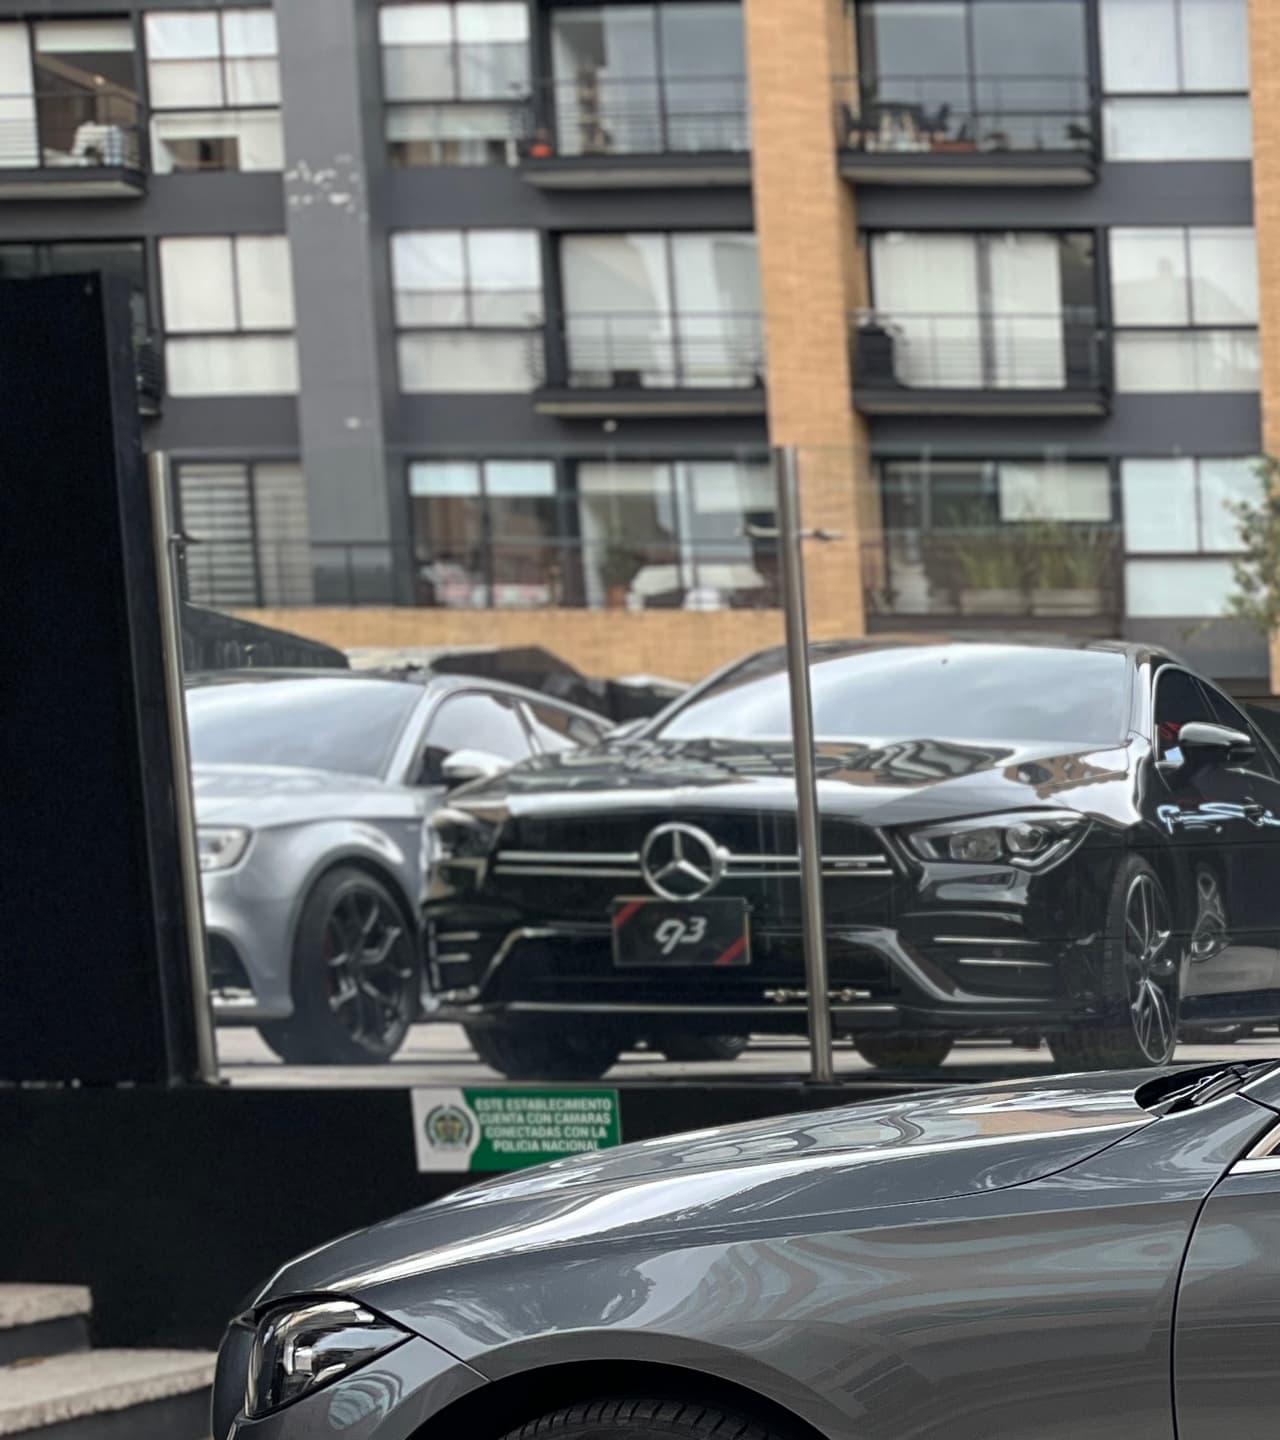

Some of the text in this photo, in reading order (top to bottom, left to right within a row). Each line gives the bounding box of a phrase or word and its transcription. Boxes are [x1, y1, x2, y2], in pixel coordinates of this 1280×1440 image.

[475, 1098, 612, 1111] ESTE ESTABLECIMIENTO
[479, 1112, 611, 1125] CUENTA CON CAMARAS
[485, 1126, 607, 1138] CONECTADAS CON LA
[493, 1140, 600, 1152] POLICIA NACIONAL
